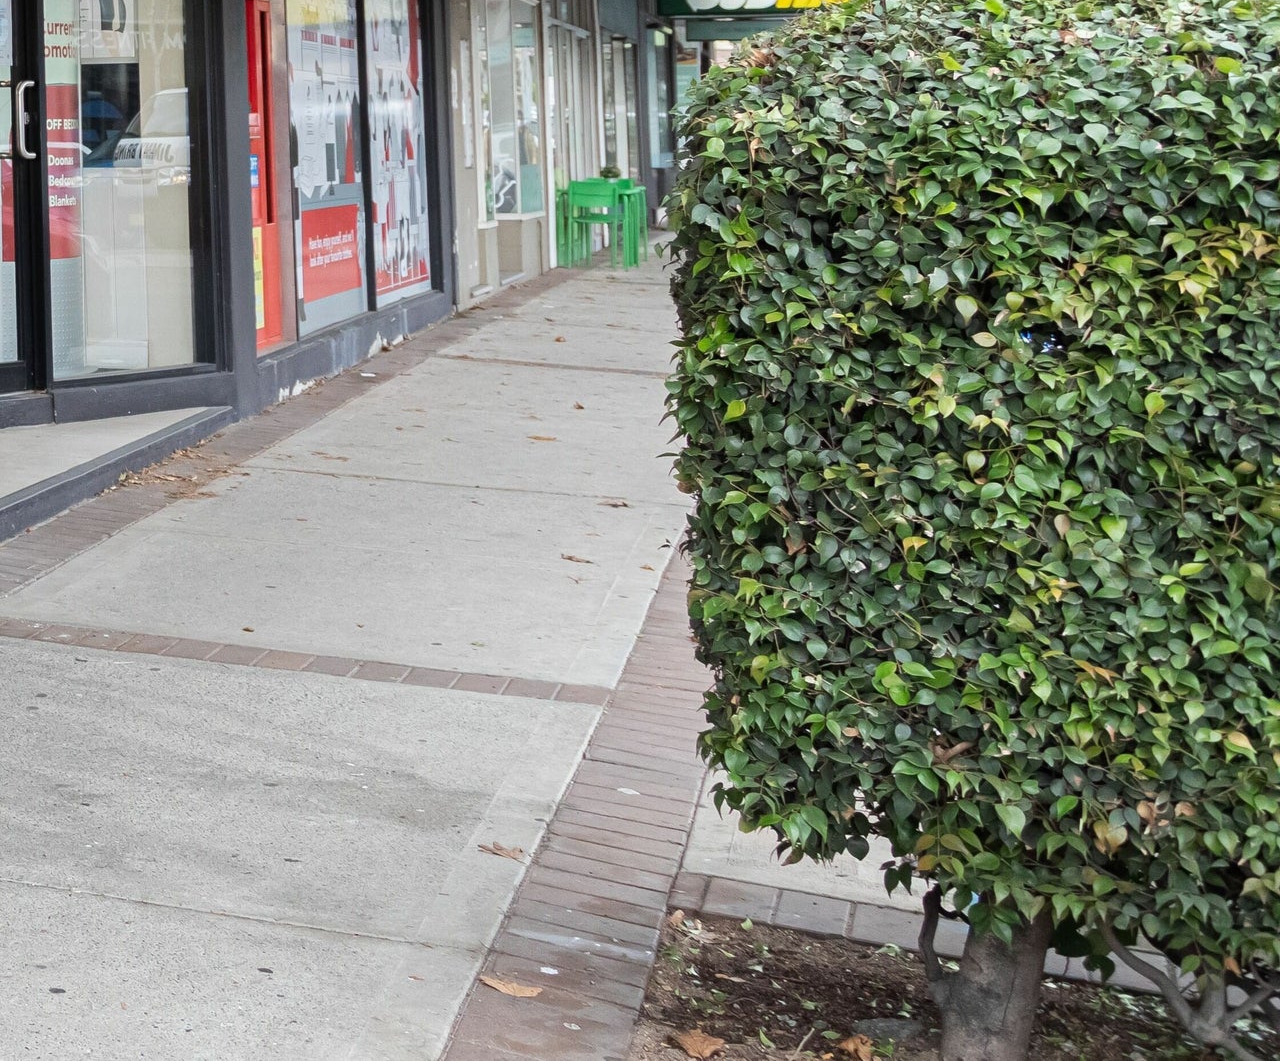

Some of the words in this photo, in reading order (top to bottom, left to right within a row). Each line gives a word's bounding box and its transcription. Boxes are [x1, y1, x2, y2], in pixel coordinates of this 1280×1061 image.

[46, 119, 62, 130] OFF
[48, 154, 74, 166] Doonas
[48, 194, 77, 207] Blankets
